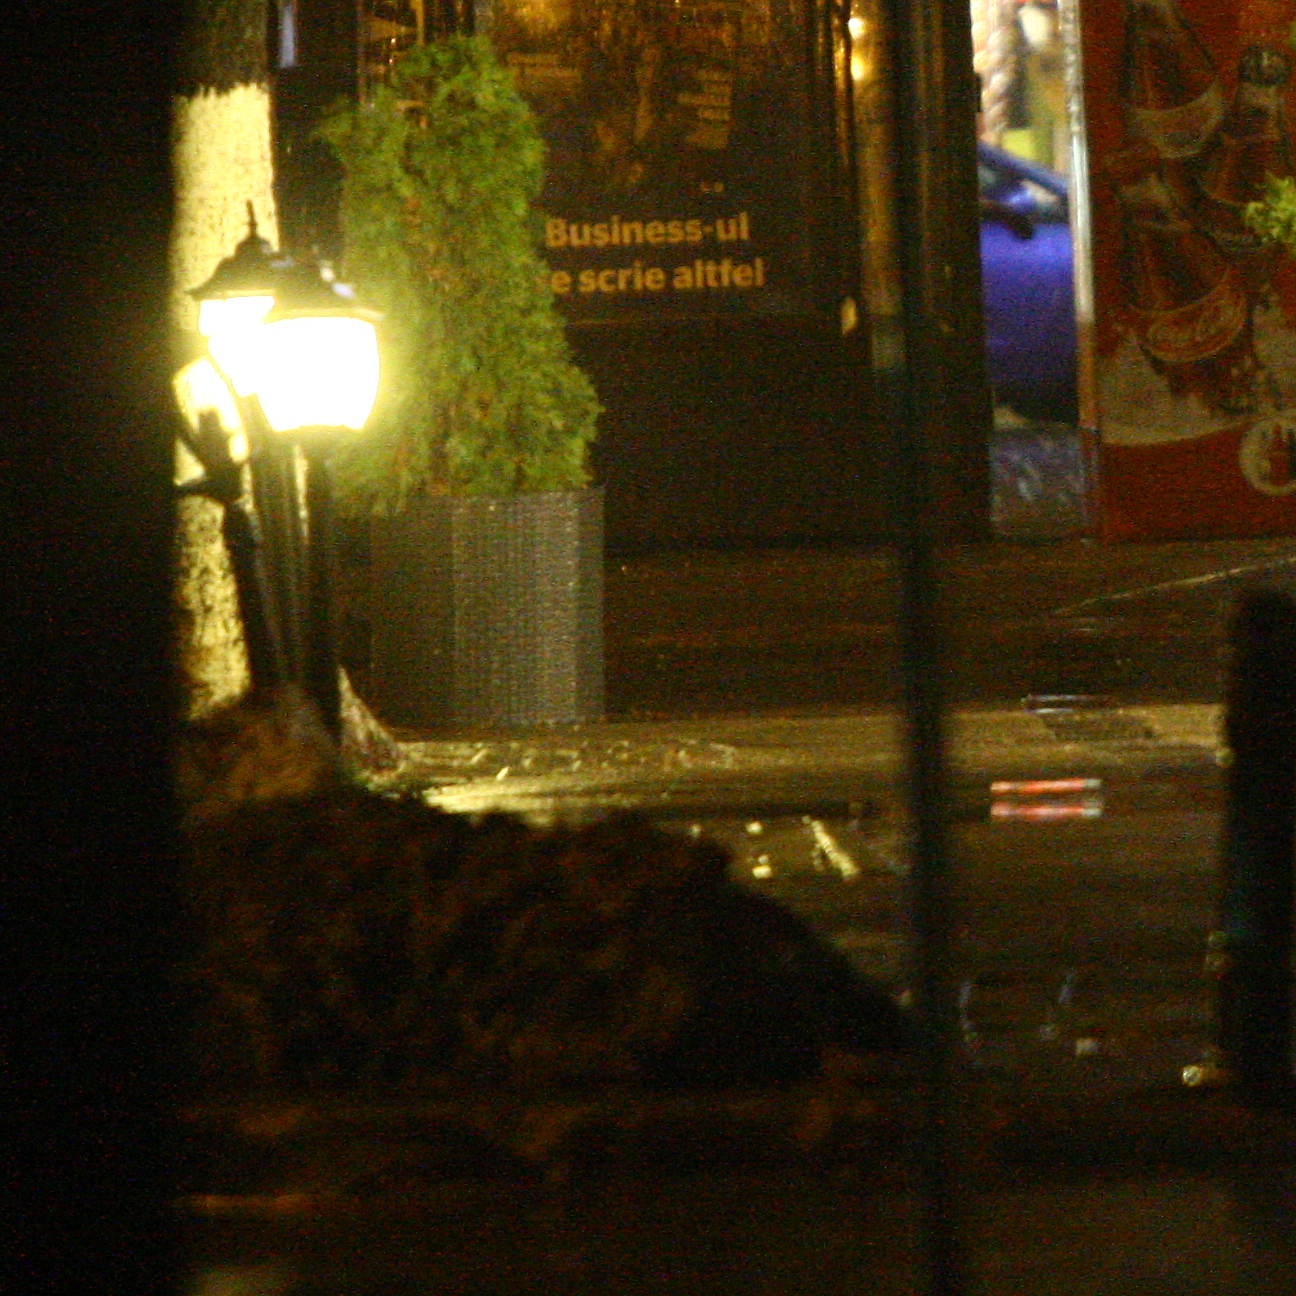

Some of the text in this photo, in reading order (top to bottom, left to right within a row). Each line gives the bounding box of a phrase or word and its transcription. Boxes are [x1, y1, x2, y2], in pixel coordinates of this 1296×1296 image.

[545, 211, 750, 247] Business-ul
[578, 260, 666, 293] scrie
[673, 257, 767, 290] altfel
